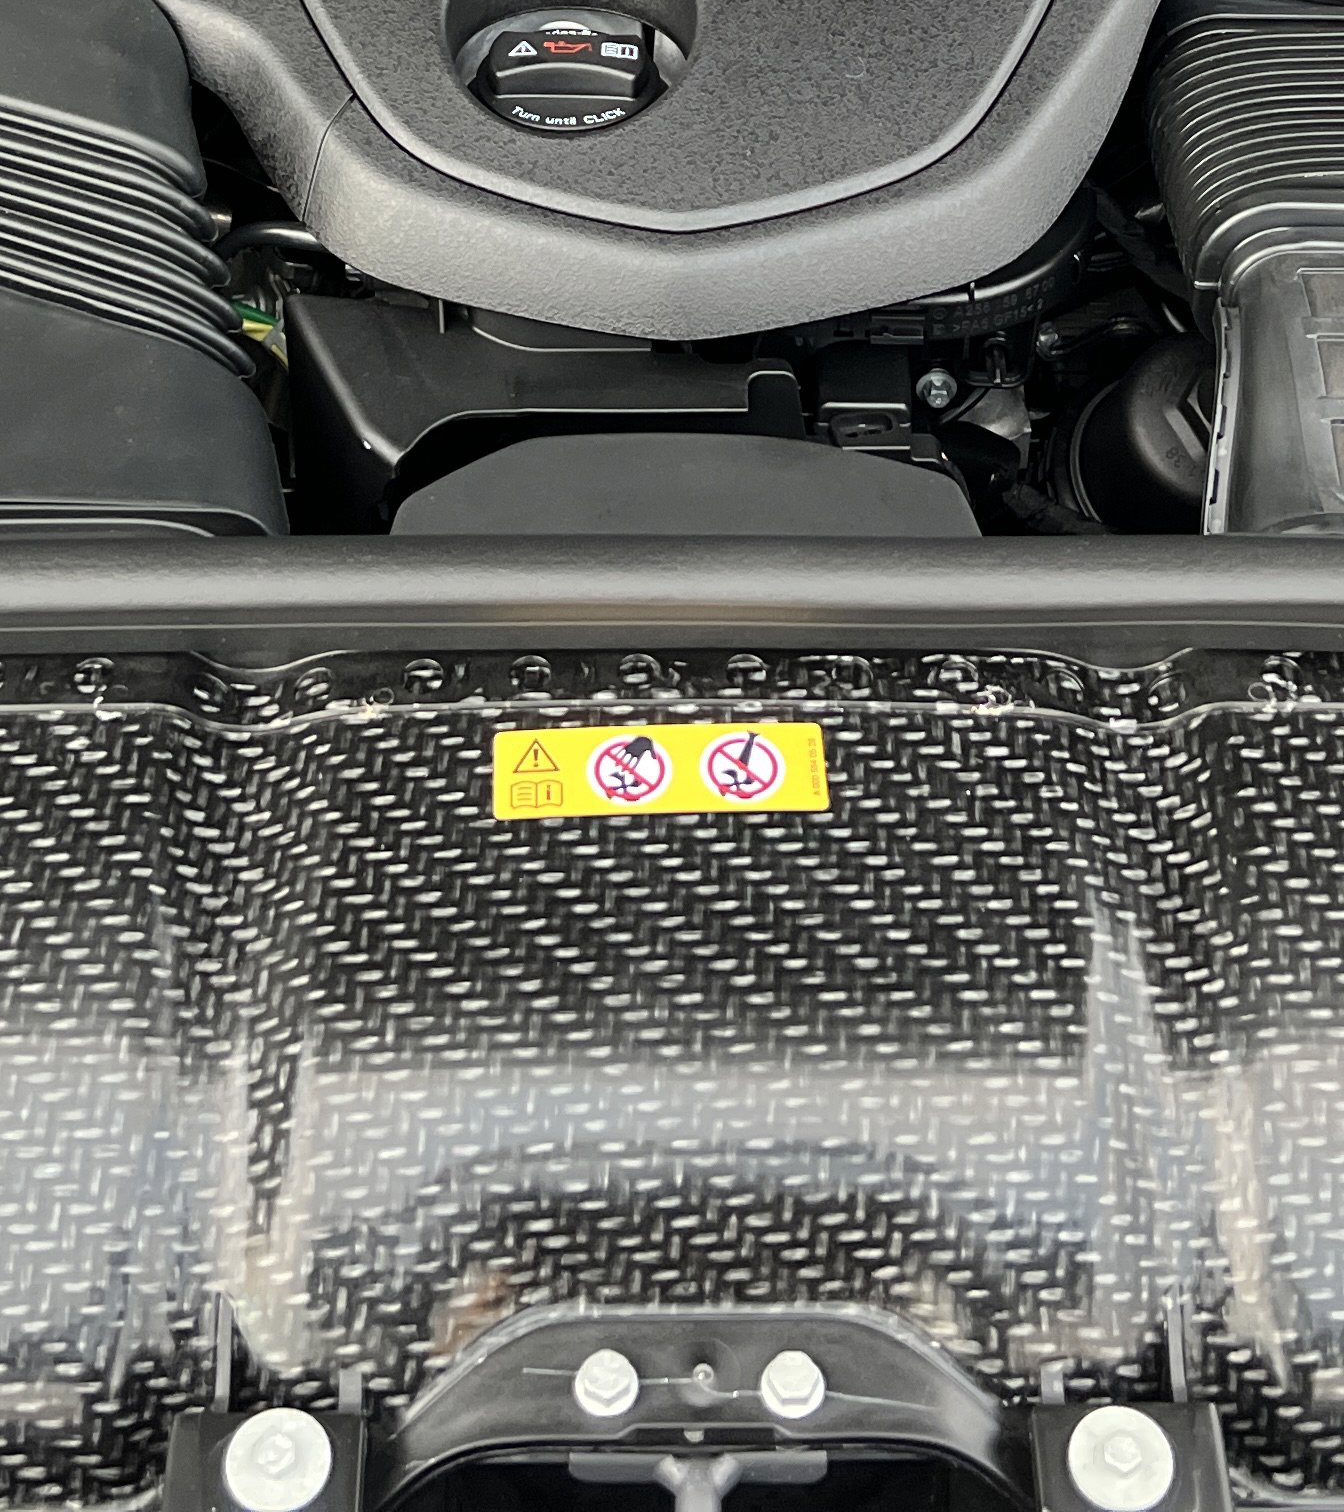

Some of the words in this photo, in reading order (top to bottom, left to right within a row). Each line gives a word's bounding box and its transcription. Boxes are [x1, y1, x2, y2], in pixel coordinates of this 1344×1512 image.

[512, 106, 541, 122] Turn
[545, 116, 577, 126] until
[583, 107, 626, 125] CLICK
